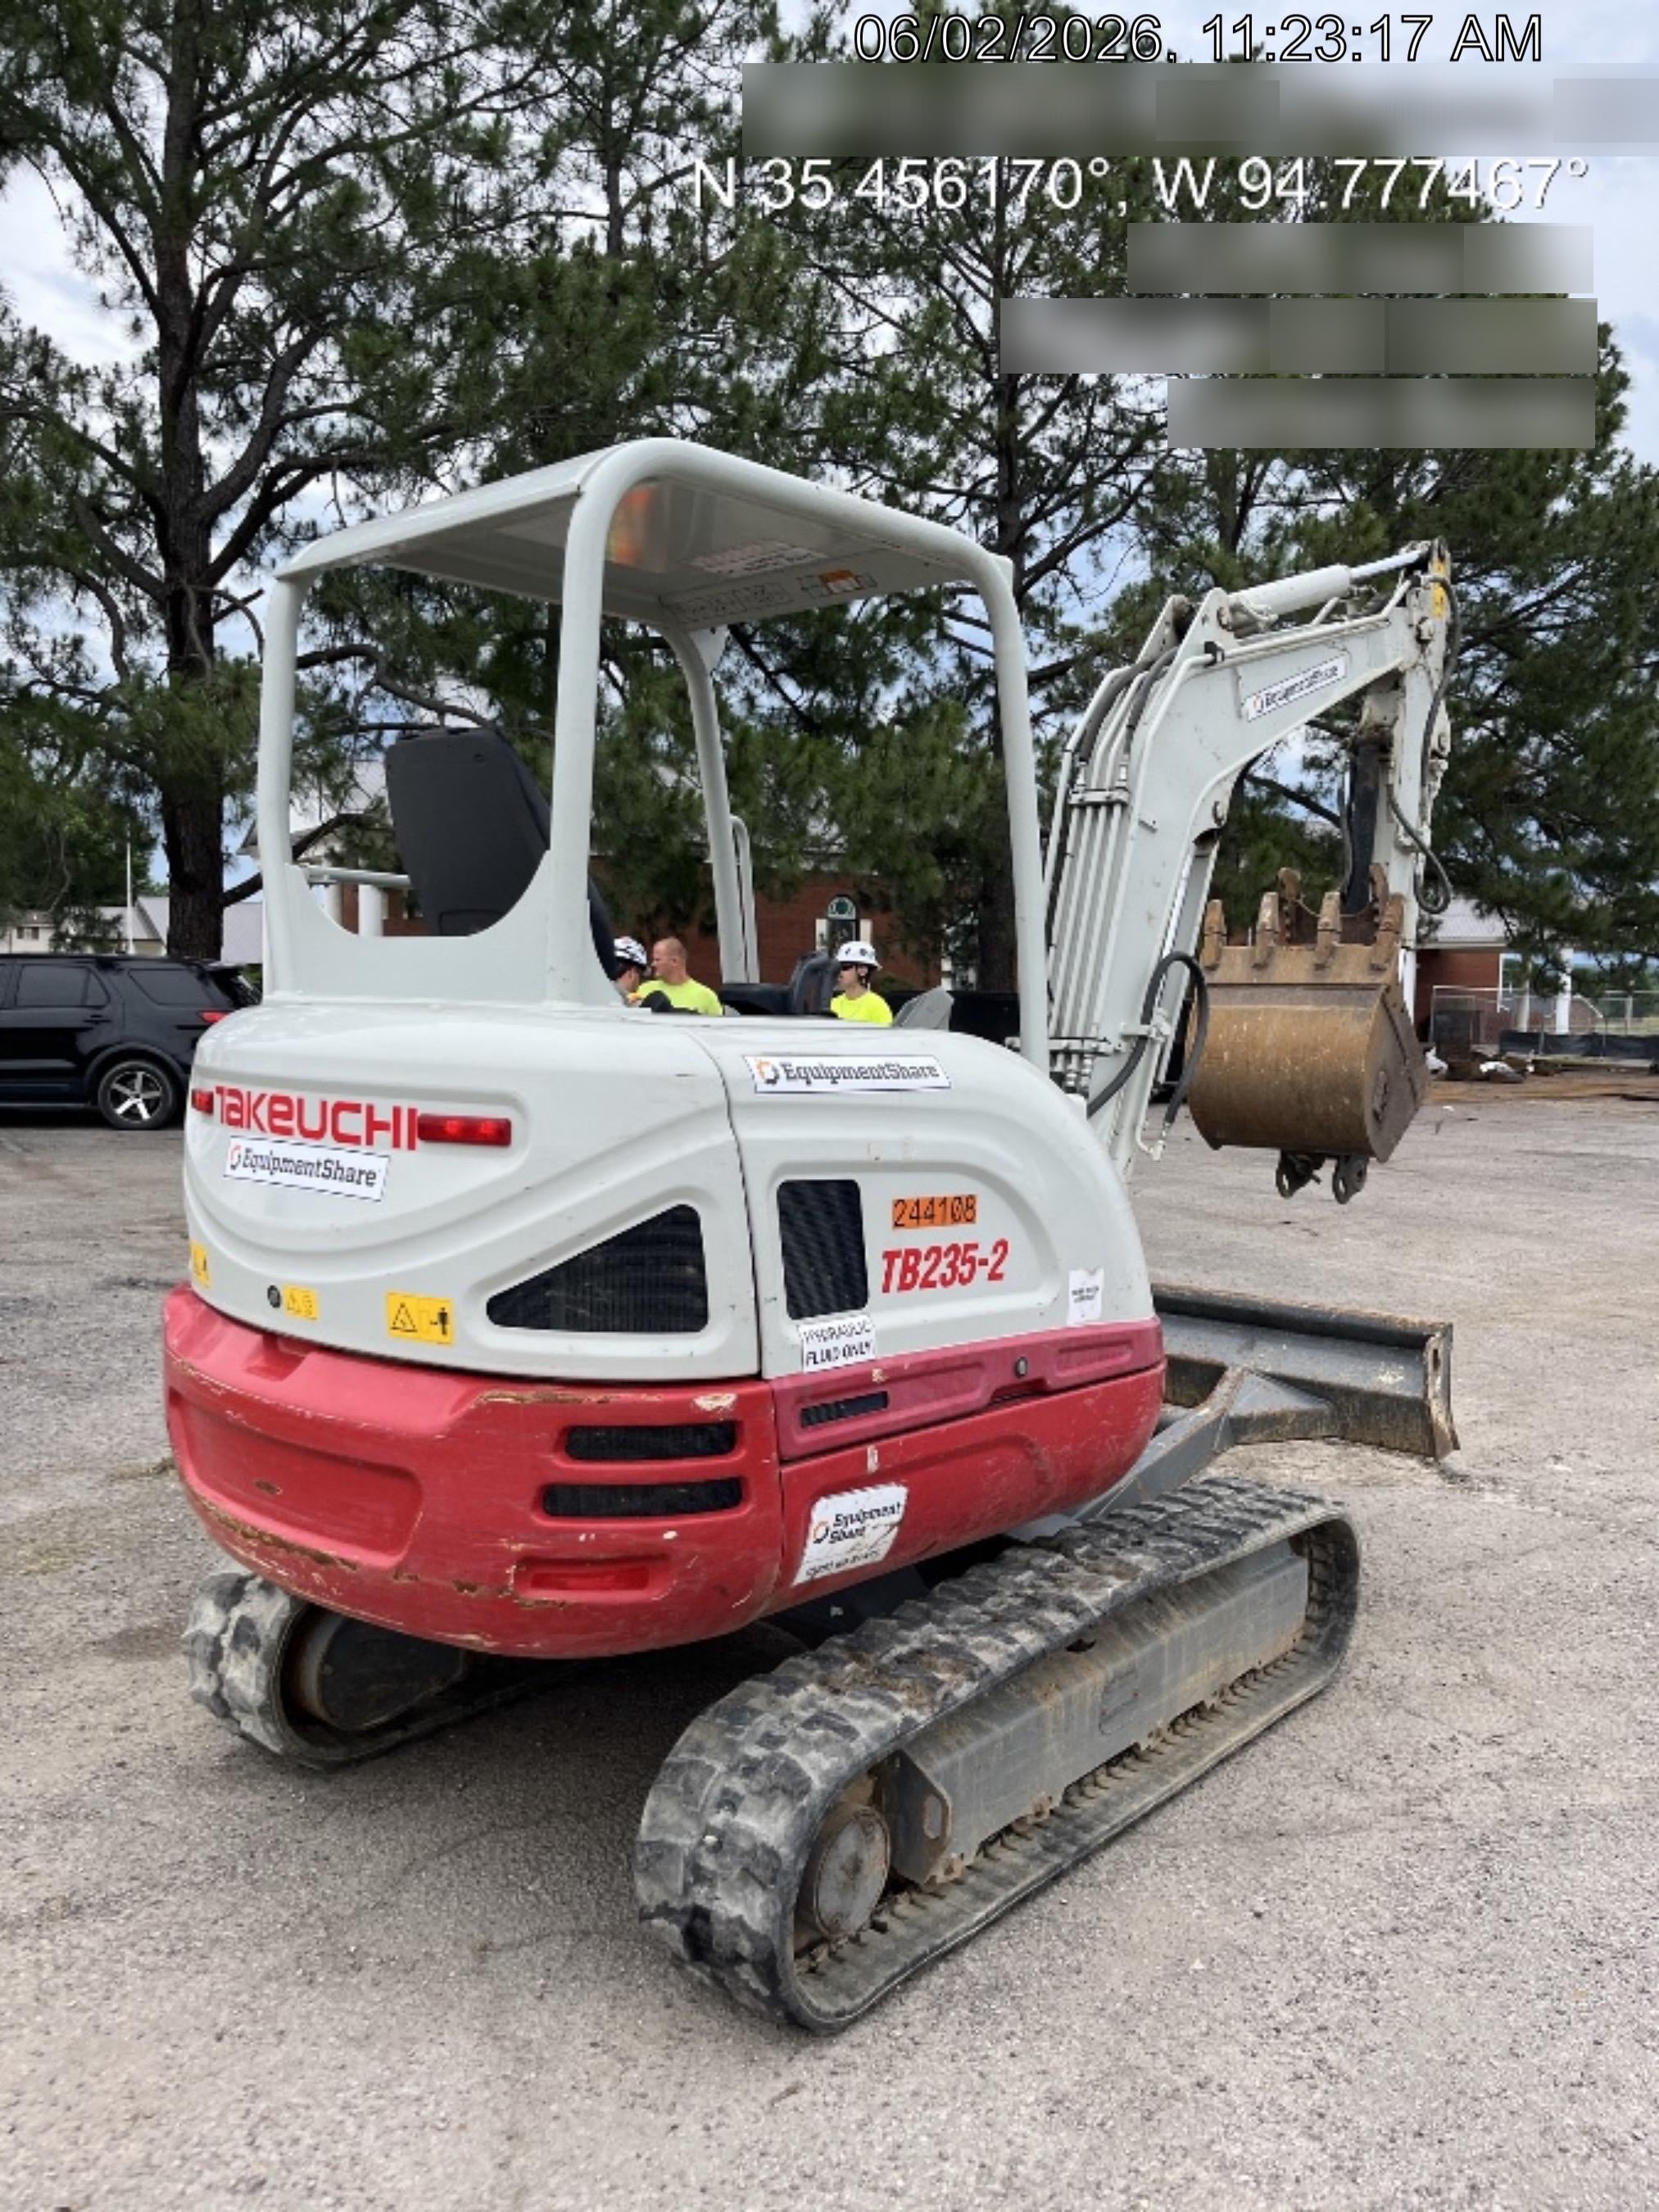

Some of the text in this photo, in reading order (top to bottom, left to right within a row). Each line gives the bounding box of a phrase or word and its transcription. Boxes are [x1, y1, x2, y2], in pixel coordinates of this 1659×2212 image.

[782, 1063, 940, 1086] EquipmentShare
[243, 1148, 378, 1187] EquipmentShare
[893, 1194, 977, 1227] 244108
[882, 1238, 1009, 1294] TB235-2
